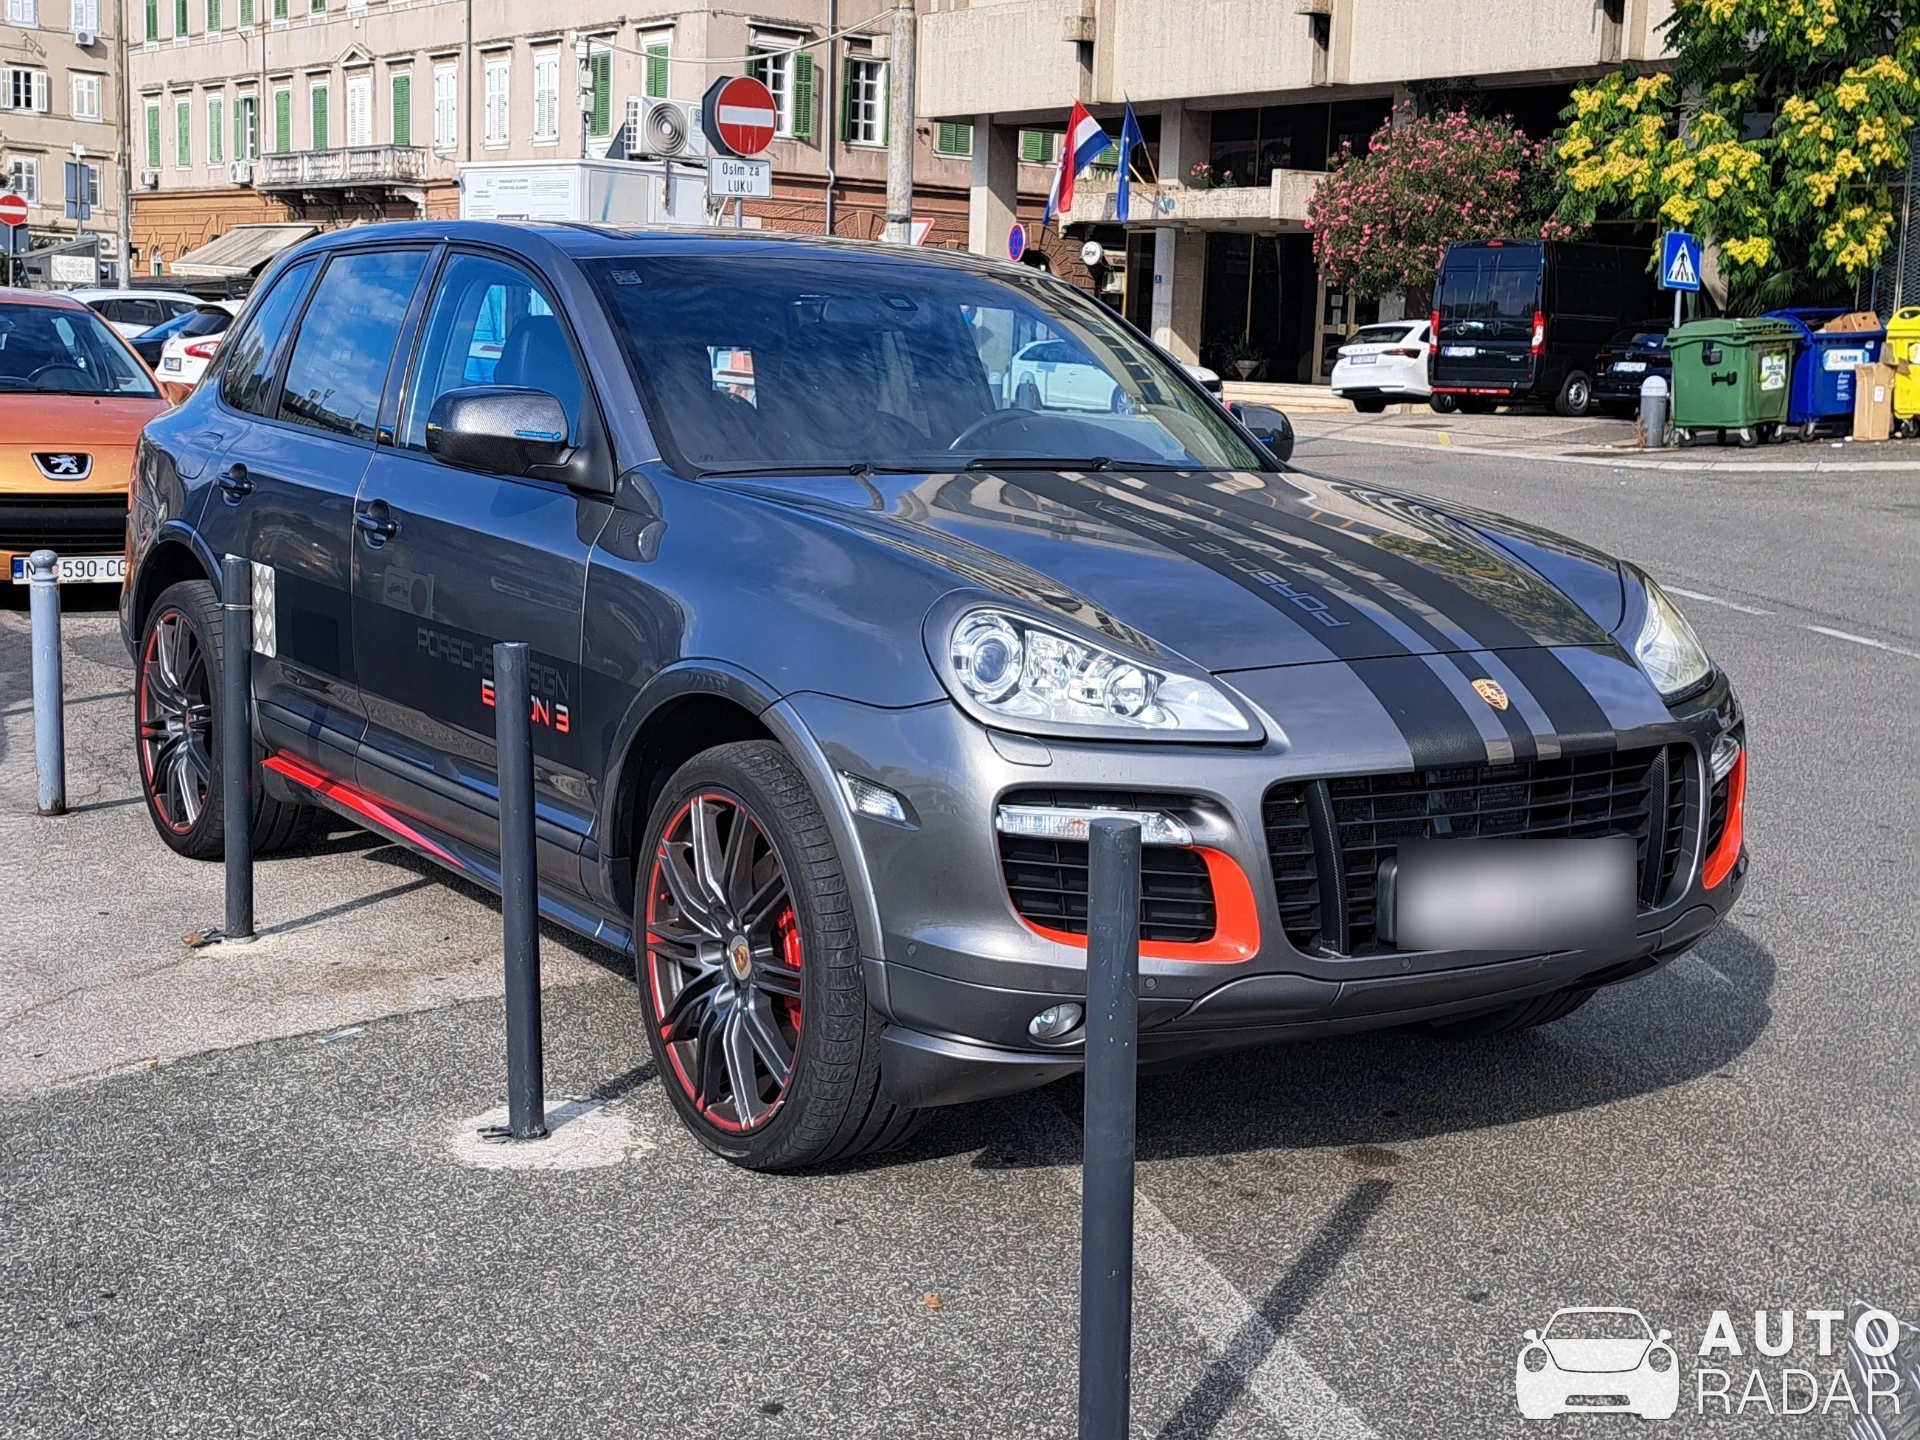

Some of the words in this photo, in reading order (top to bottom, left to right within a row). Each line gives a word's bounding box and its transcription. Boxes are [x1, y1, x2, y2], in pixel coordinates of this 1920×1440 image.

[728, 180, 753, 193] LUKU
[749, 166, 760, 177] za
[1188, 541, 1351, 628] PORSCHE
[529, 661, 570, 700] SIGN
[555, 703, 570, 734] 3
